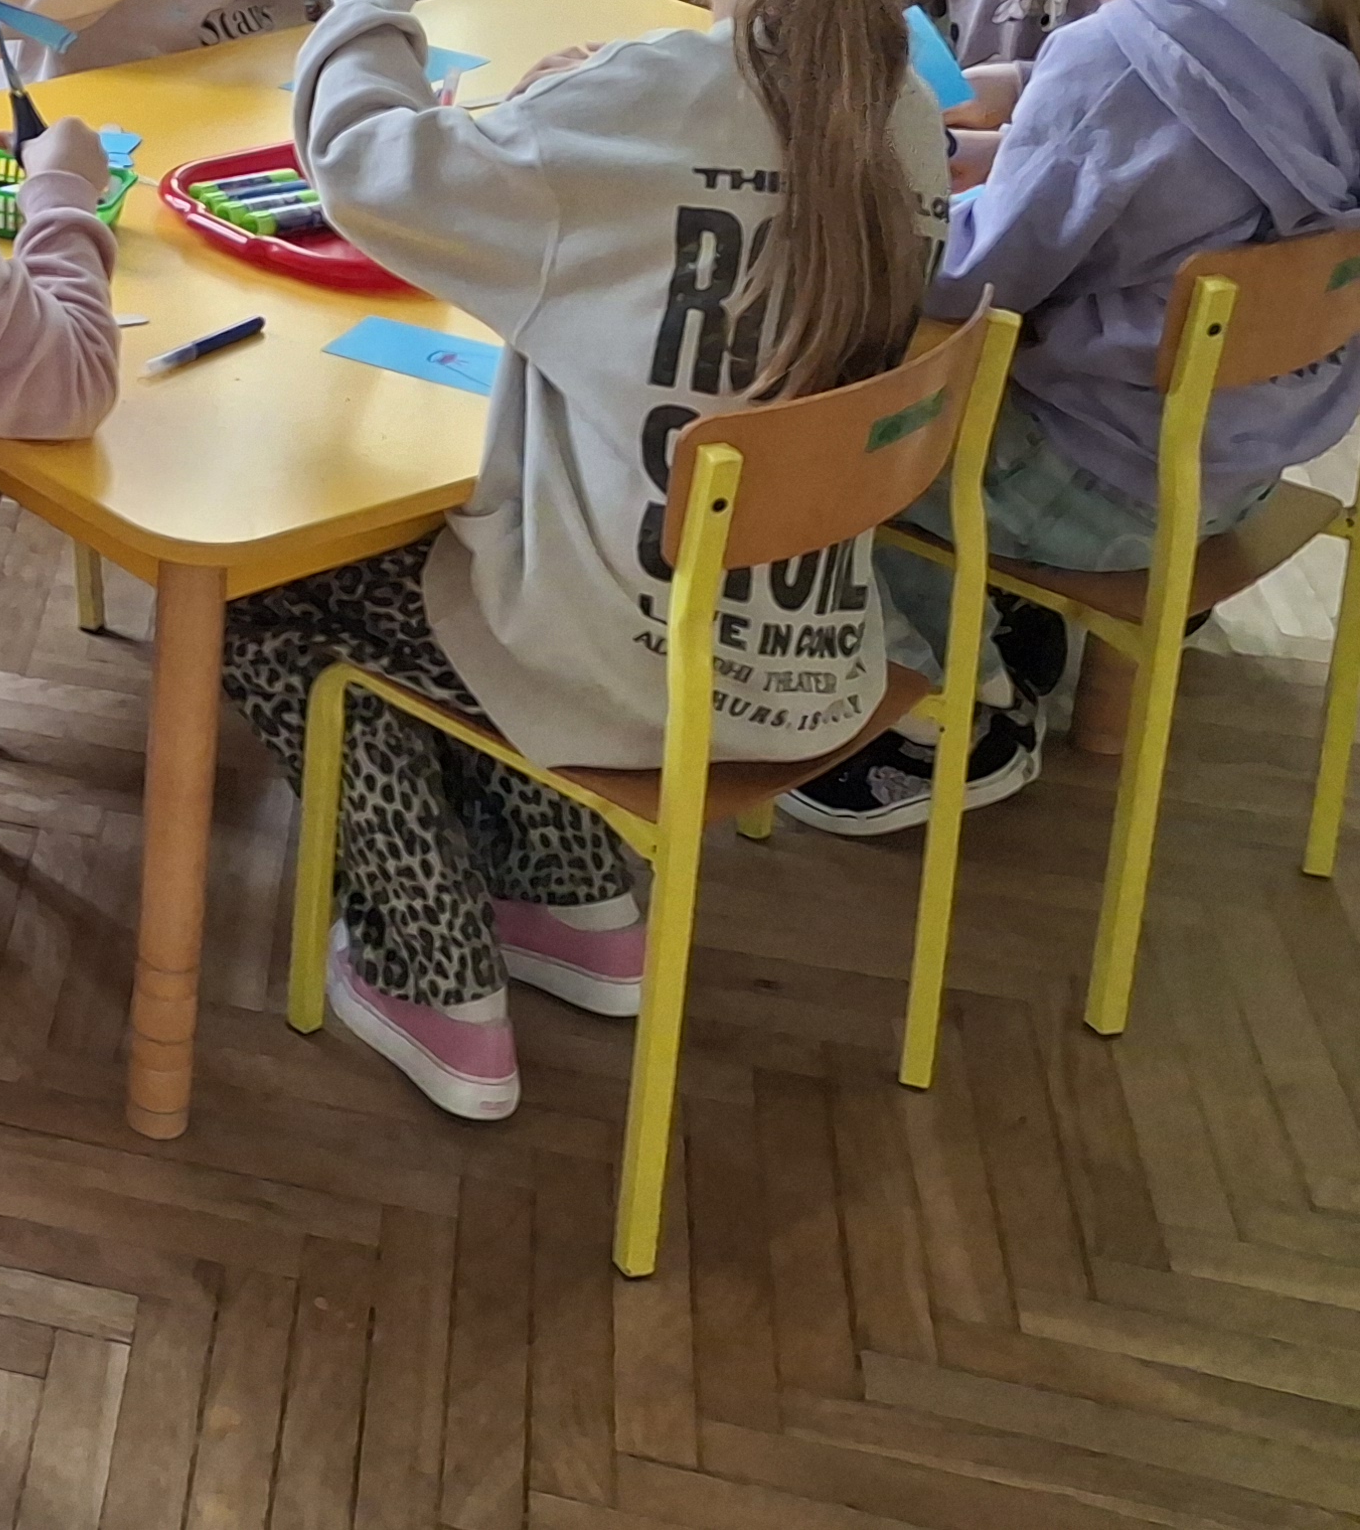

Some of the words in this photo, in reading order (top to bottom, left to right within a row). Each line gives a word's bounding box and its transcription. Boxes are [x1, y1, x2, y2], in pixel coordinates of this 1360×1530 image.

[199, 4, 274, 47] Stars
[757, 622, 794, 657] IN
[712, 689, 792, 728] HURS.
